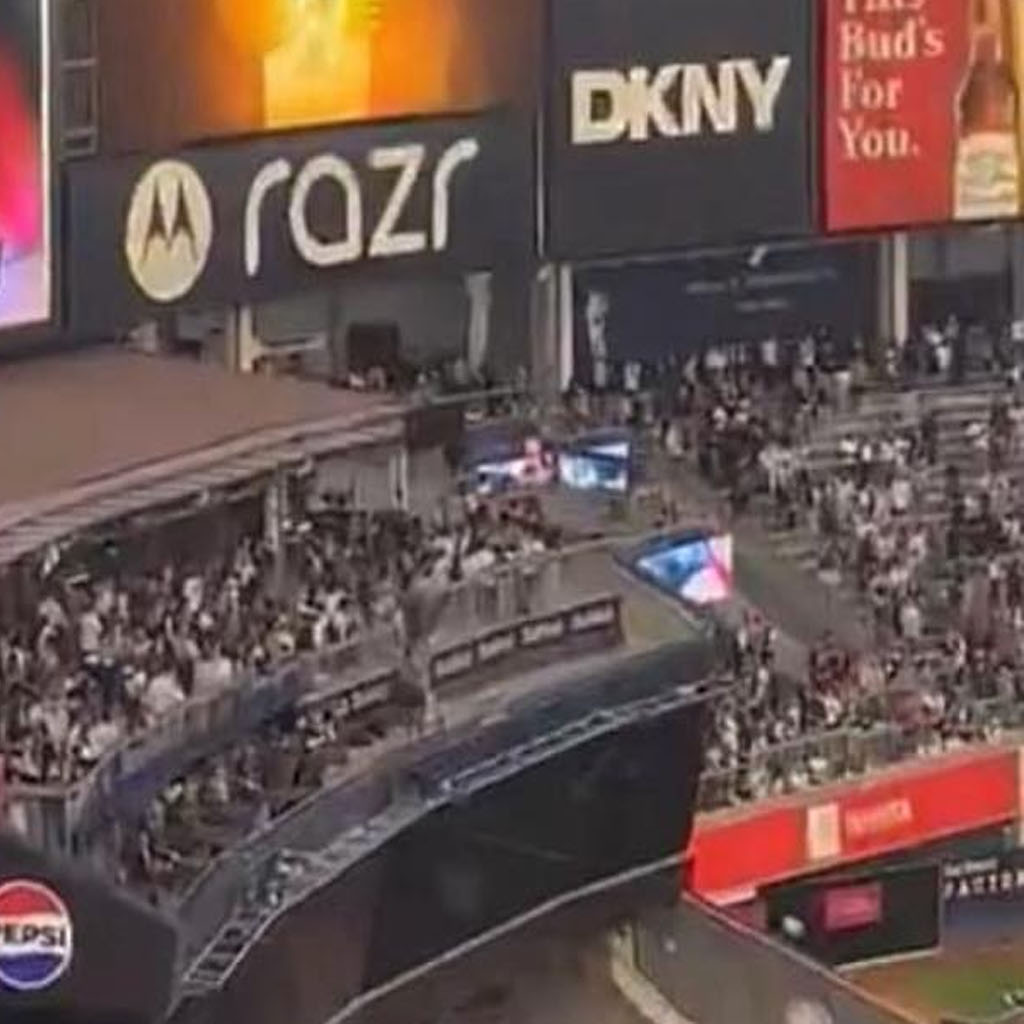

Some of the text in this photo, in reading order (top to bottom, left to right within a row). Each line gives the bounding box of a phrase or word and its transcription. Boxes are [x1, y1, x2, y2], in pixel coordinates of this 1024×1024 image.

[839, 16, 946, 63] Bud's
[571, 56, 791, 146] DKNY
[840, 67, 903, 111] For
[838, 115, 920, 161] You.
[244, 138, 478, 276] razr
